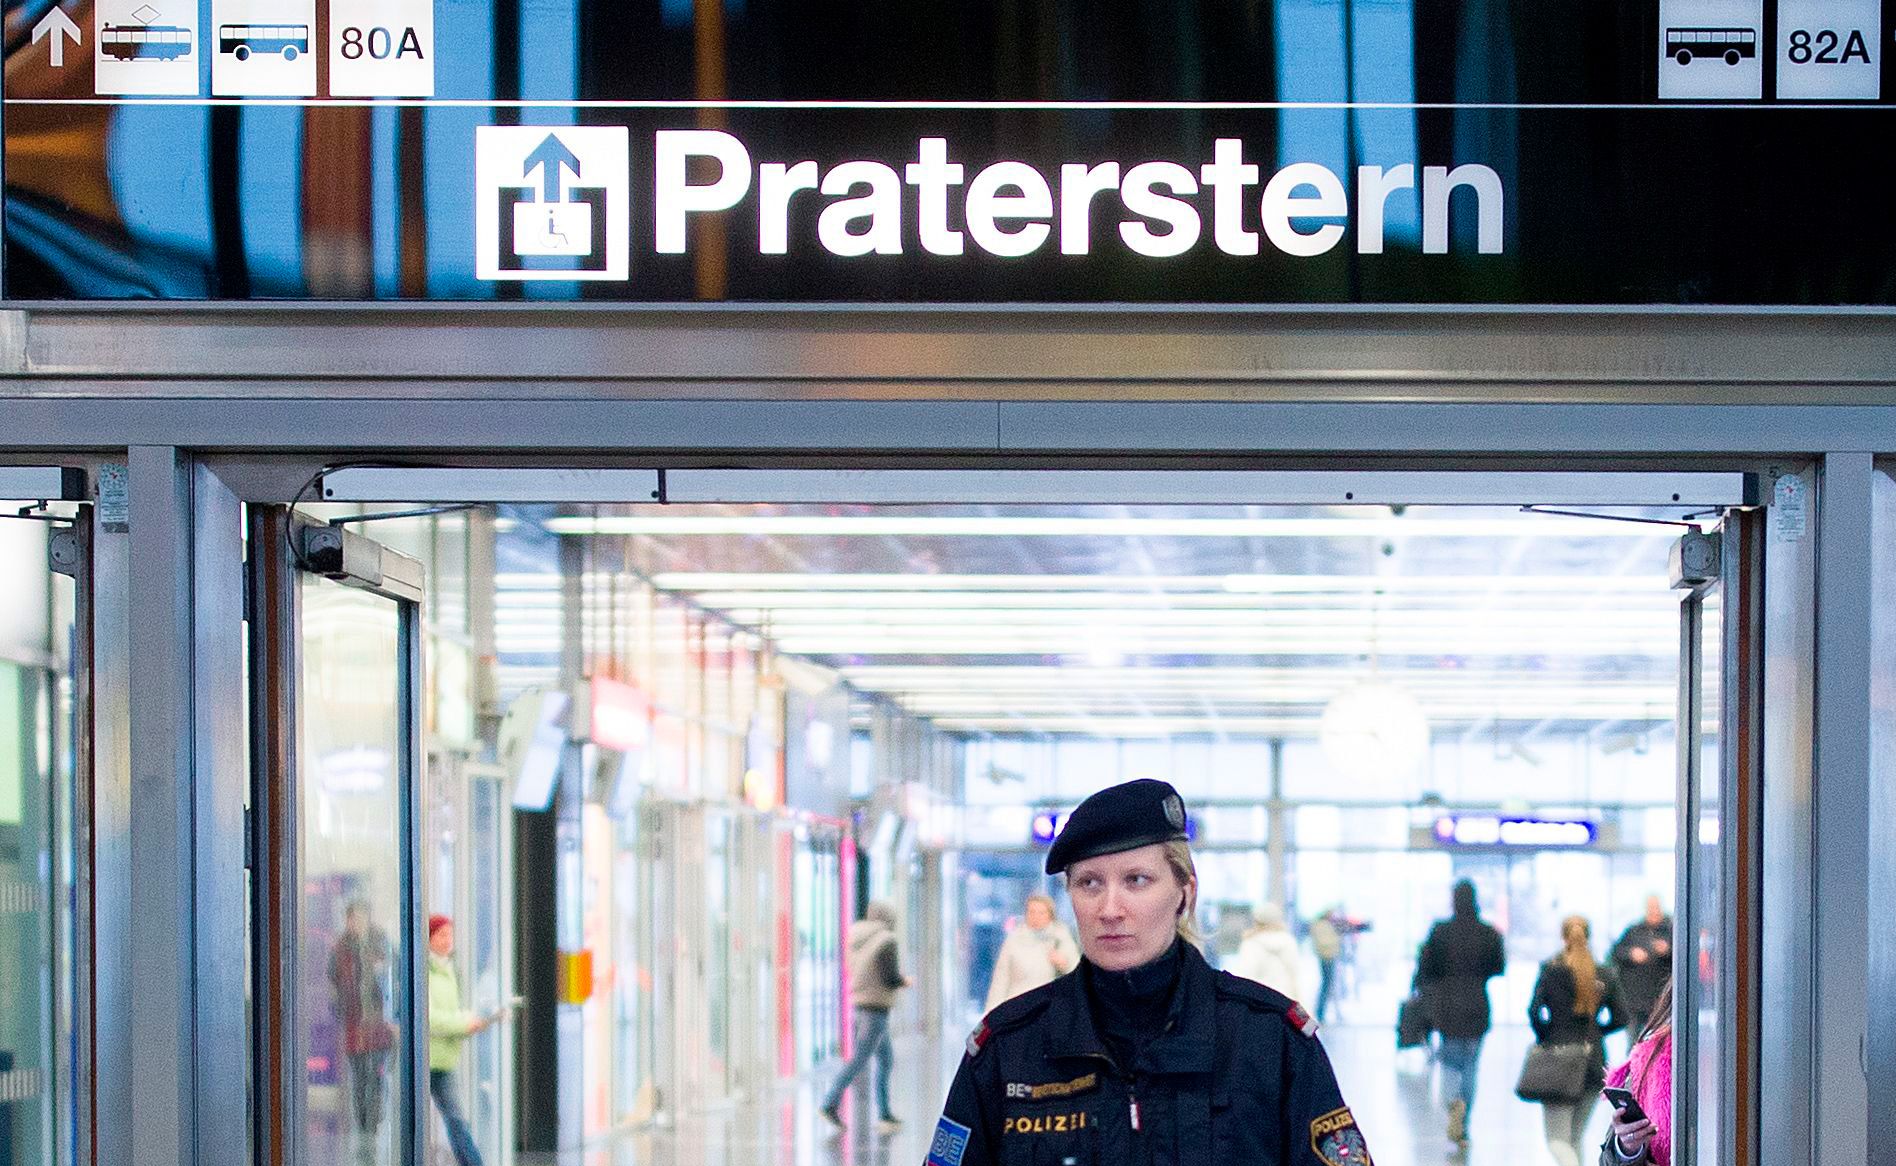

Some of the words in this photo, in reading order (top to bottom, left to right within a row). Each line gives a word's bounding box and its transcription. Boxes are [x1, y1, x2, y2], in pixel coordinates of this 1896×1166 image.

[341, 26, 424, 60] 80A
[1788, 29, 1870, 64] 82A
[655, 129, 1506, 257] Praterstern
[1004, 1112, 1086, 1134] POLIZEI
